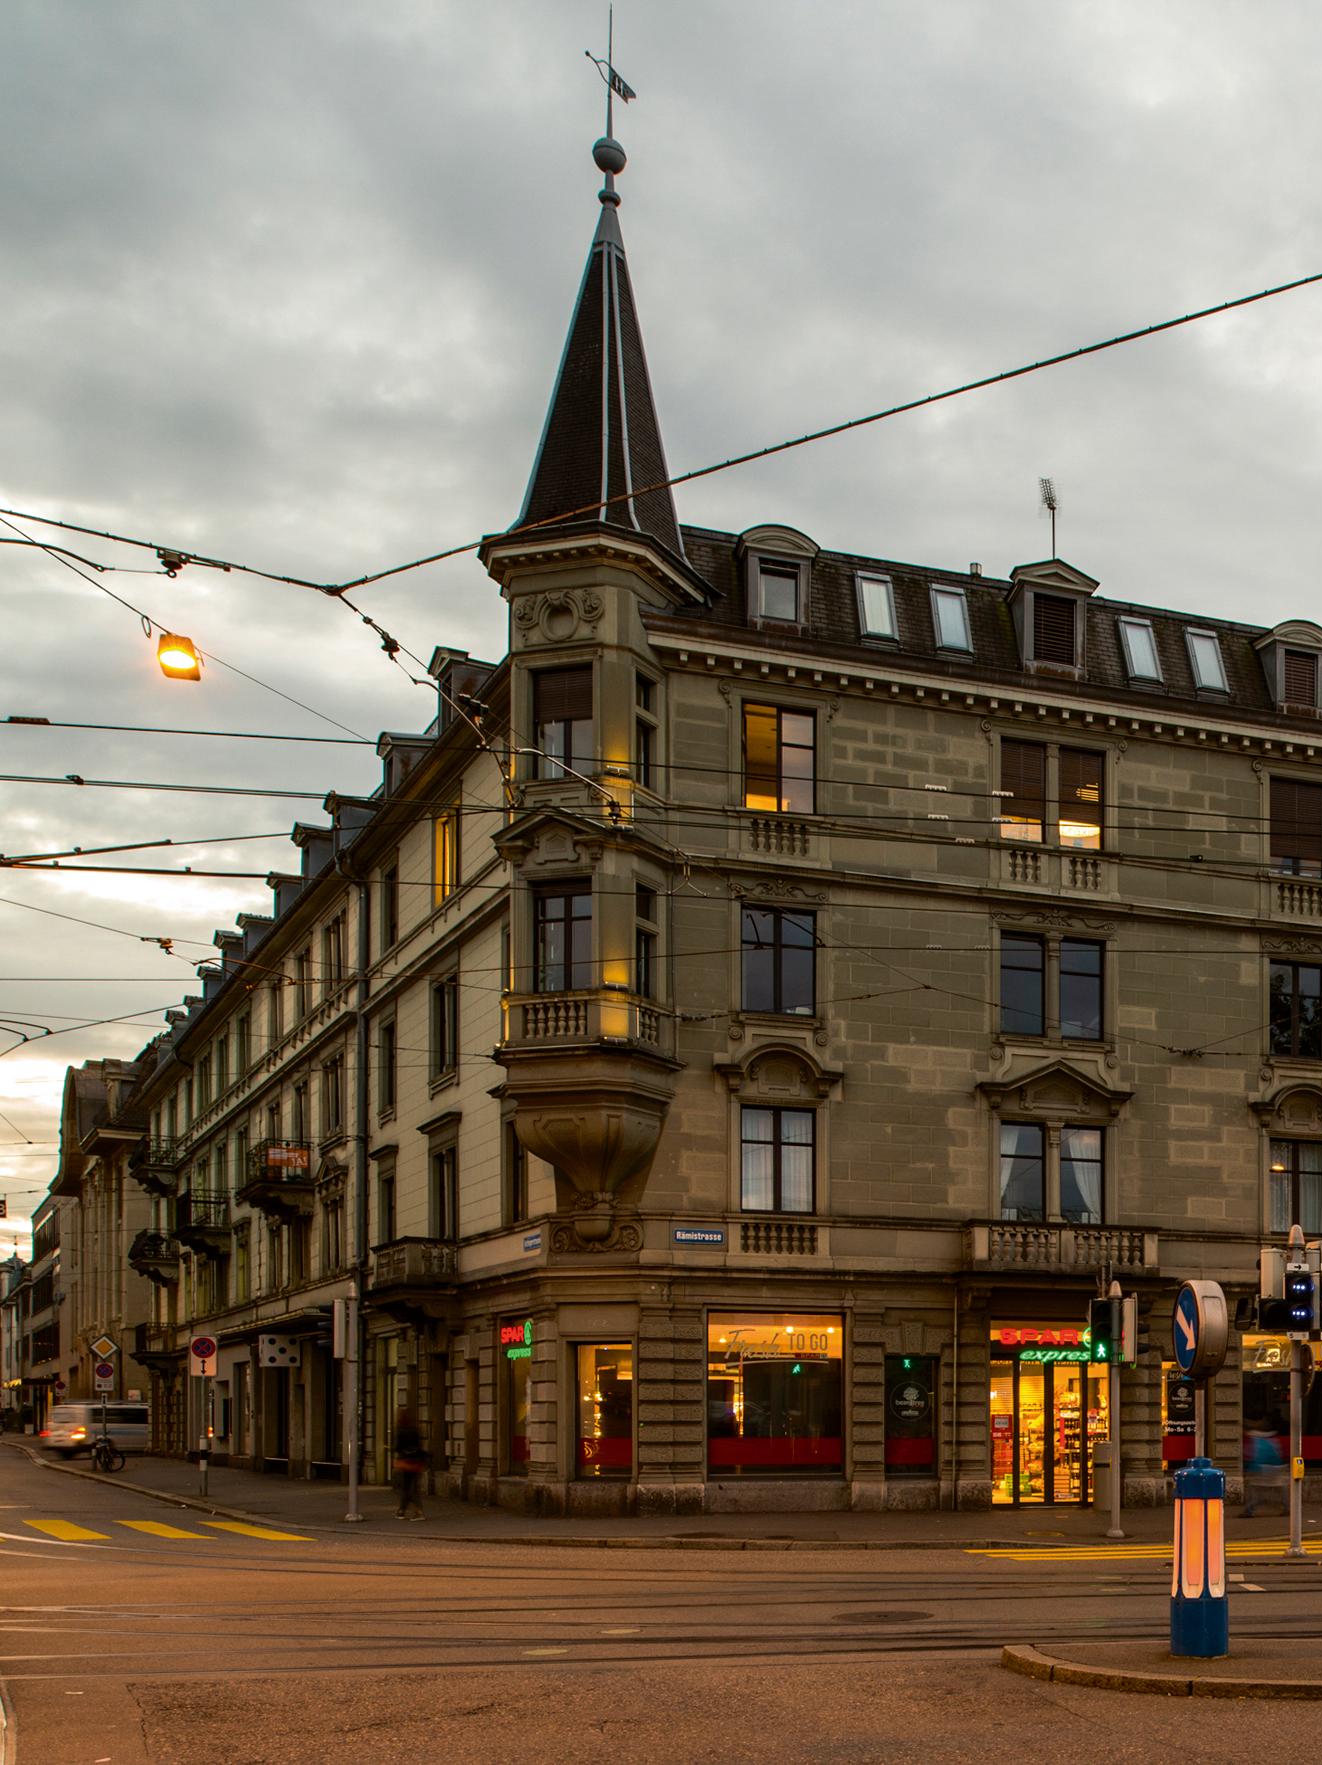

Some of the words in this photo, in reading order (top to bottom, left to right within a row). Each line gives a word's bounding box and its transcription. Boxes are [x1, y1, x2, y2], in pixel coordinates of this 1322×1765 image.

[675, 1230, 723, 1241] Rämistrasse
[501, 1326, 524, 1344] SPAR
[788, 1333, 805, 1351] TO
[810, 1333, 828, 1351] GO
[1000, 1328, 1079, 1345] SPAR
